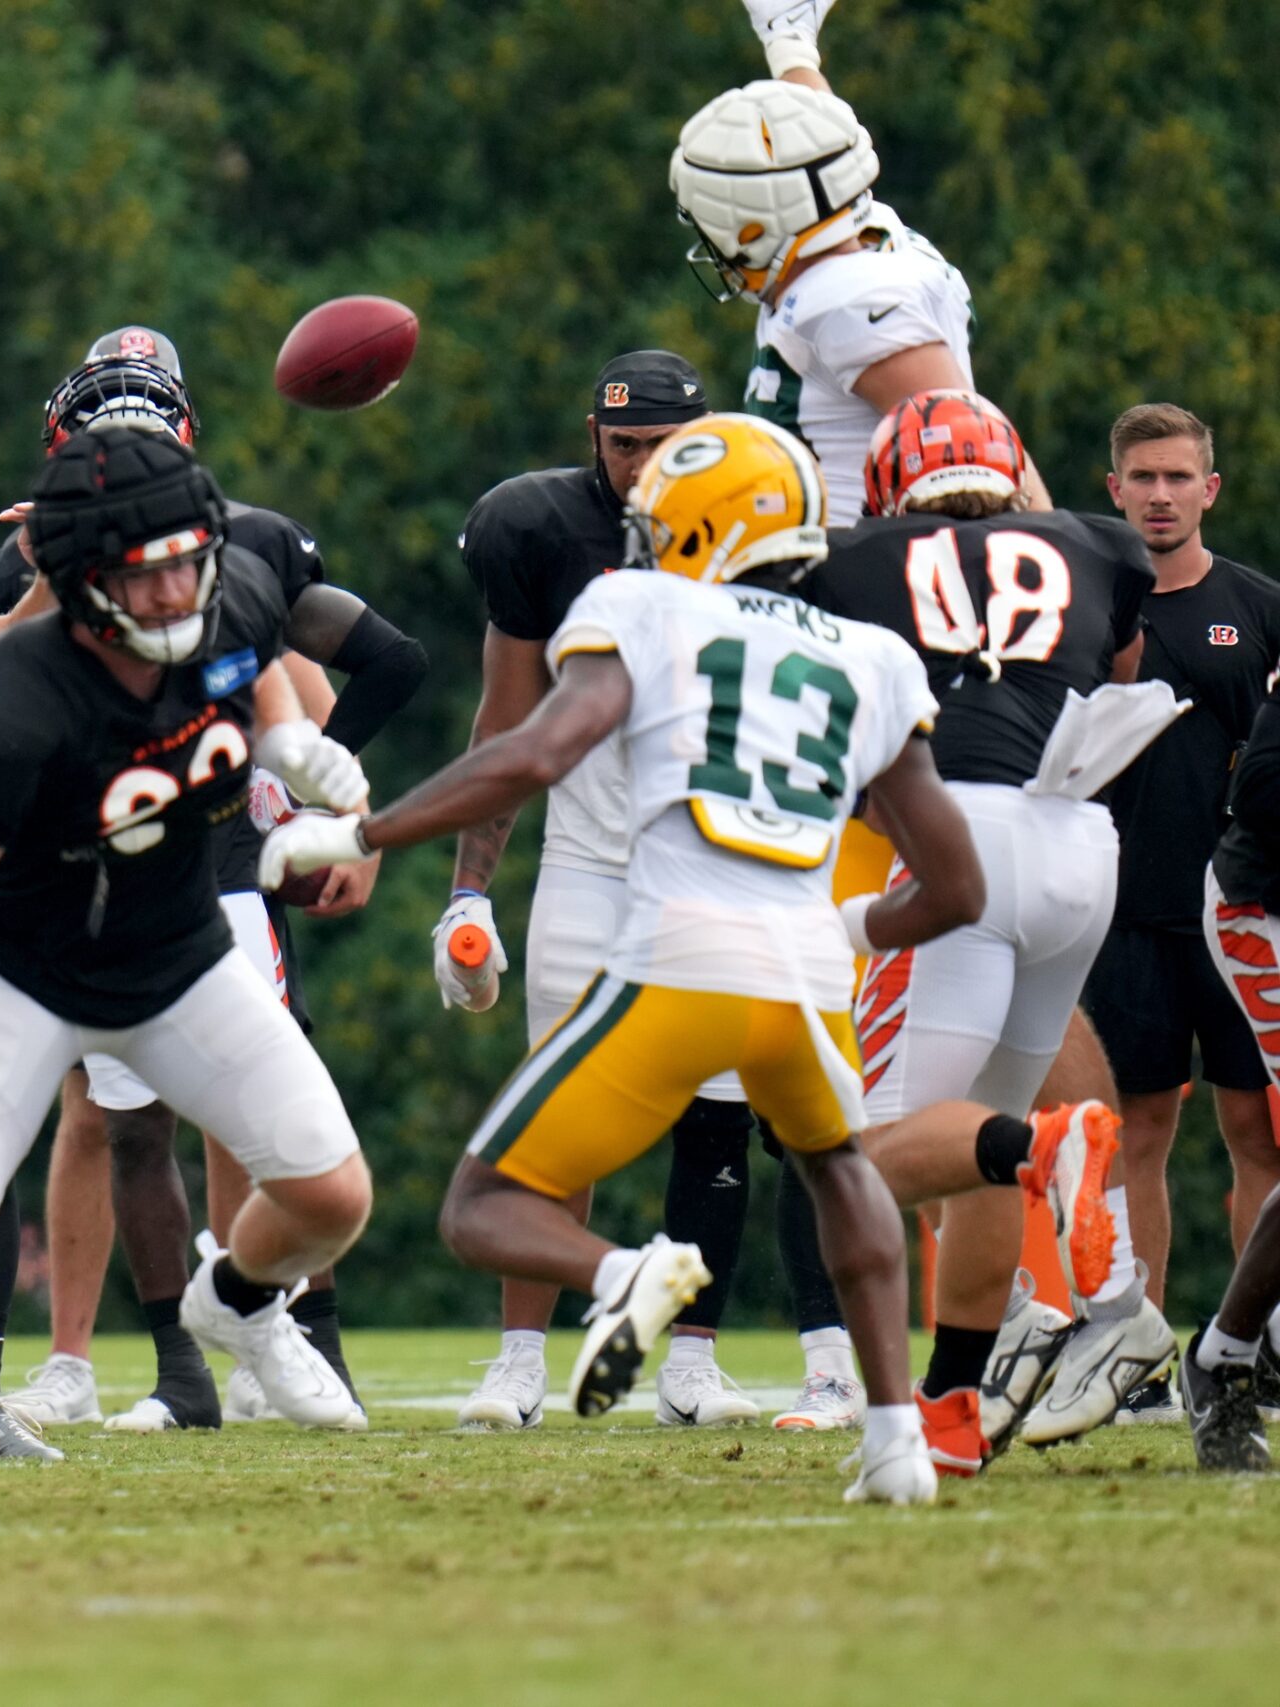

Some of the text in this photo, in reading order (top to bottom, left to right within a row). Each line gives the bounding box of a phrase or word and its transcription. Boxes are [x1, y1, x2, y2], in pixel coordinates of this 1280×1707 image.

[930, 469, 992, 483] BENGALS
[904, 526, 1072, 662] 48
[688, 636, 859, 822] 13
